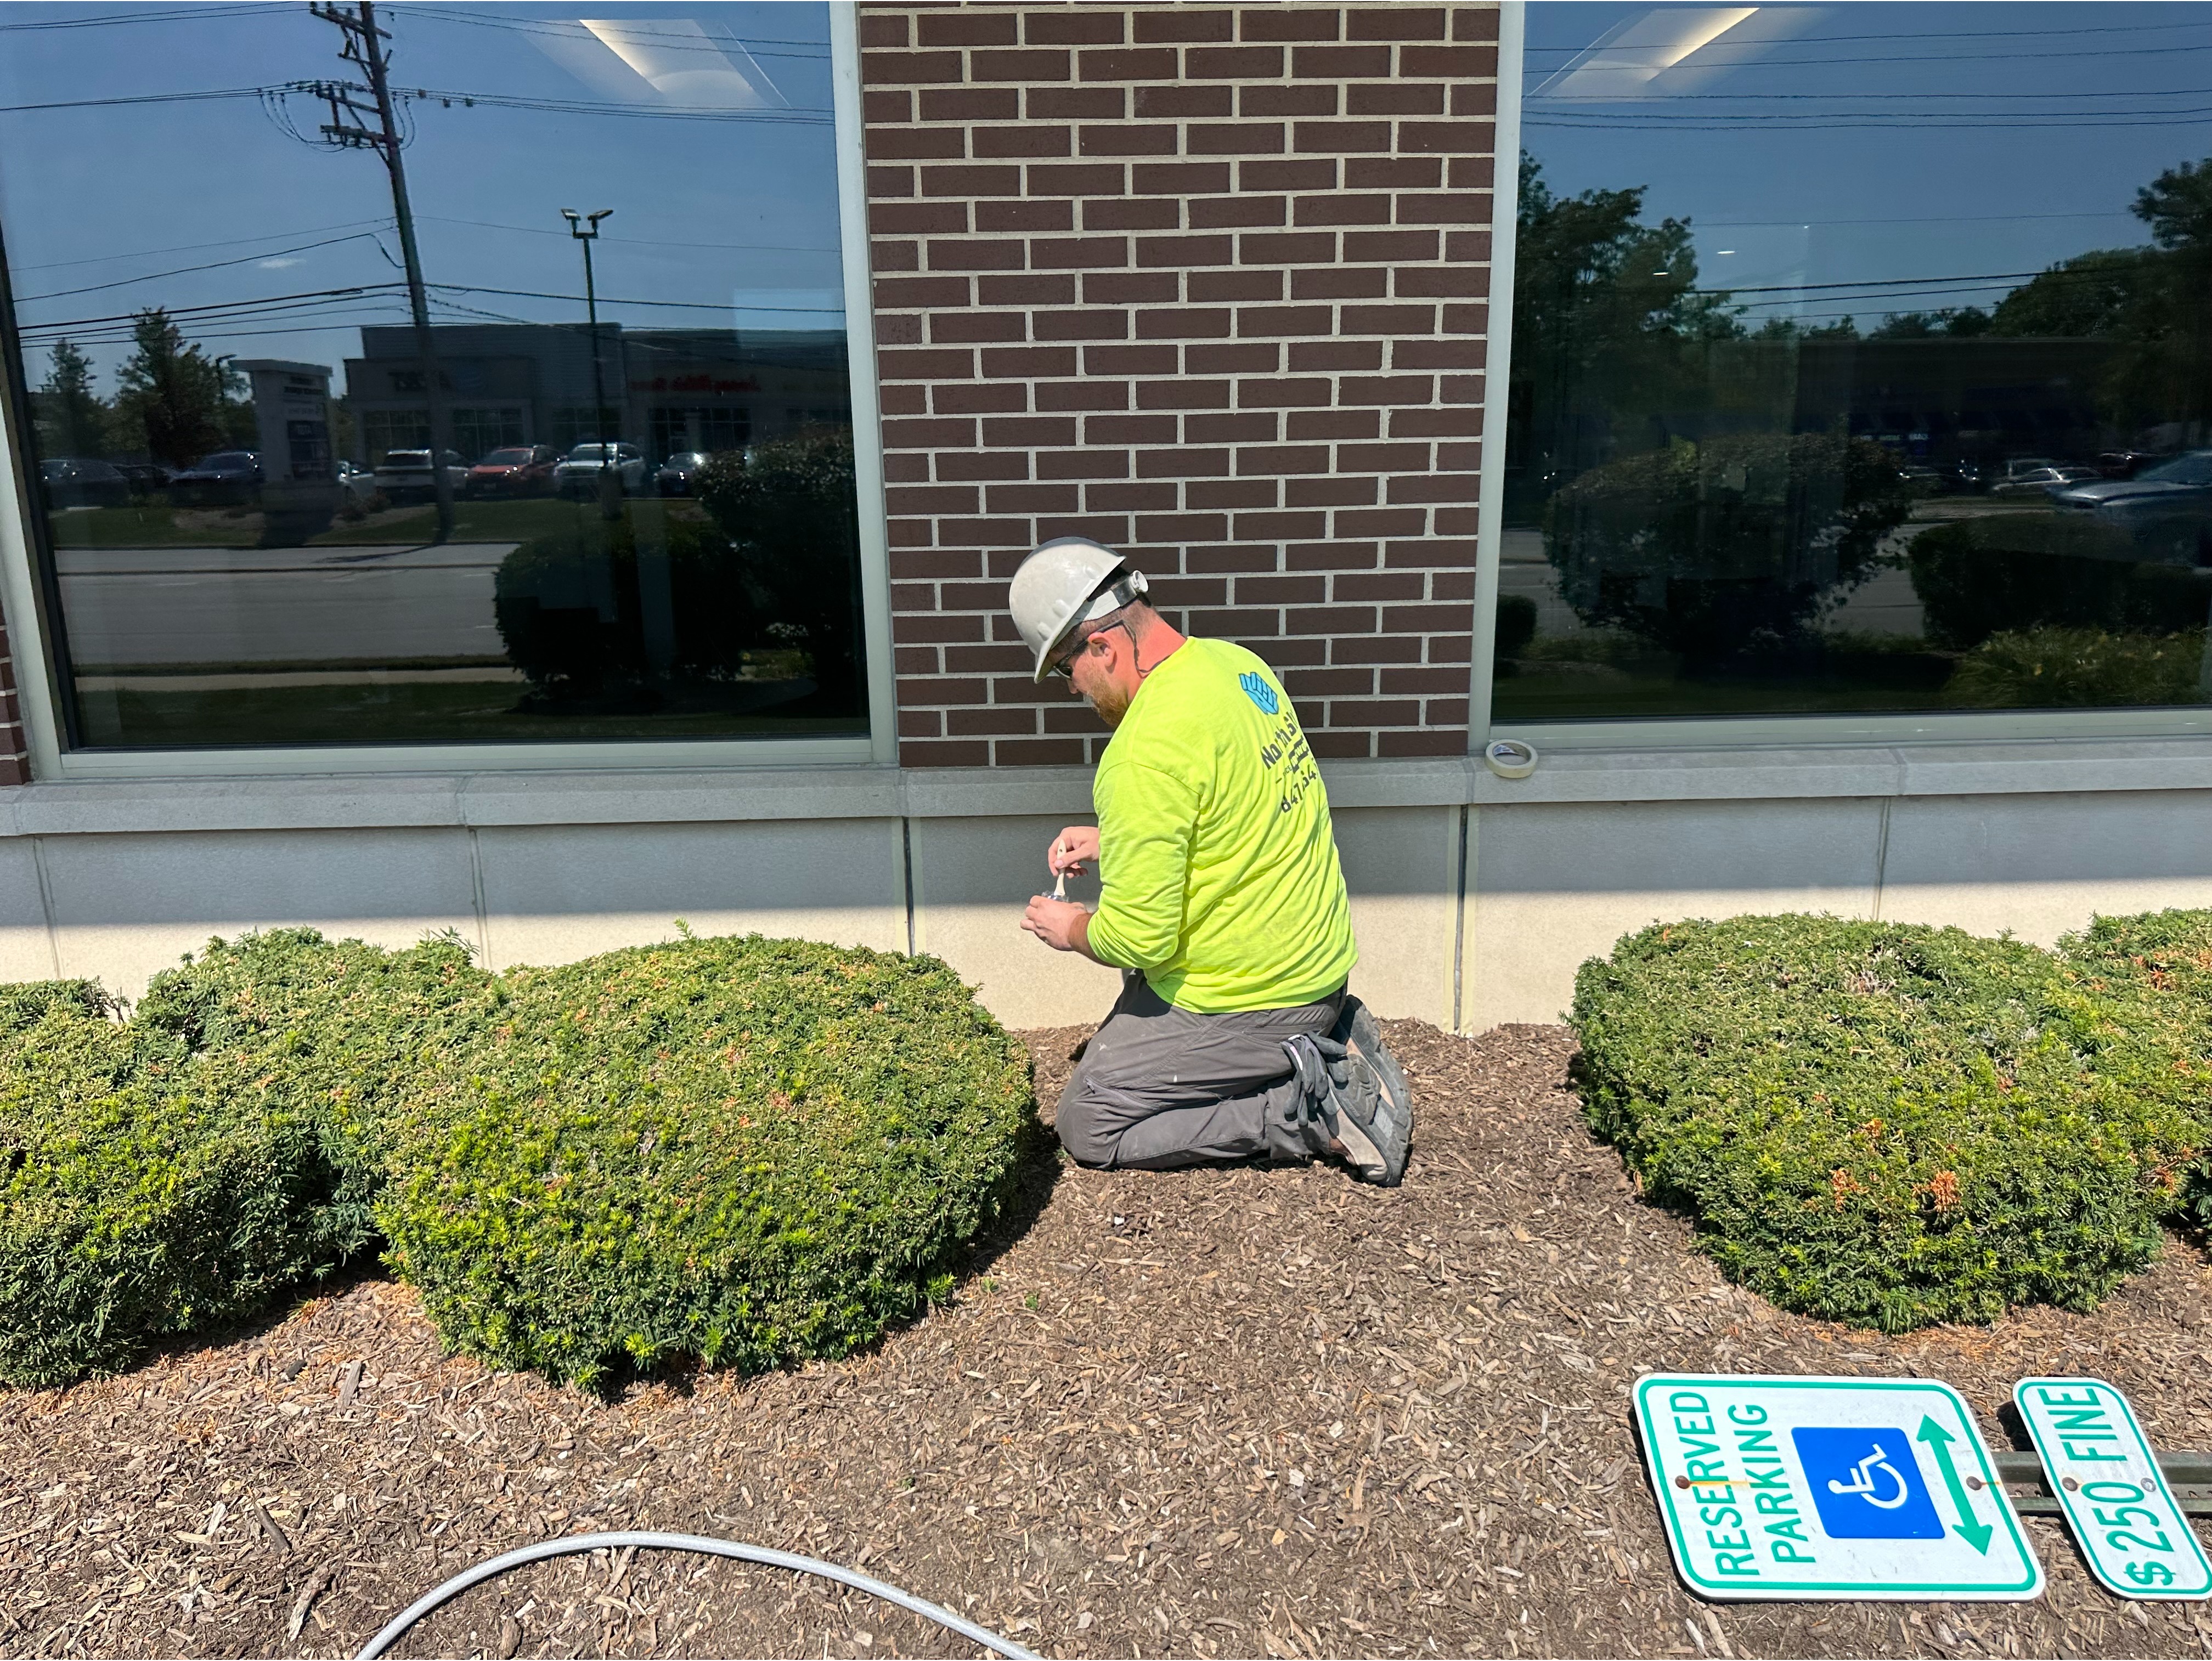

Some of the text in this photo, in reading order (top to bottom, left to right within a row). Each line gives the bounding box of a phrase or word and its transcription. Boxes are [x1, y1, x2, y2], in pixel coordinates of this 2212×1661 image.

[1262, 726, 1292, 770] North
[2037, 1388, 2128, 1462] FINE
[1669, 1392, 1760, 1576] RESERVED
[1727, 1404, 1816, 1563] PARKING
